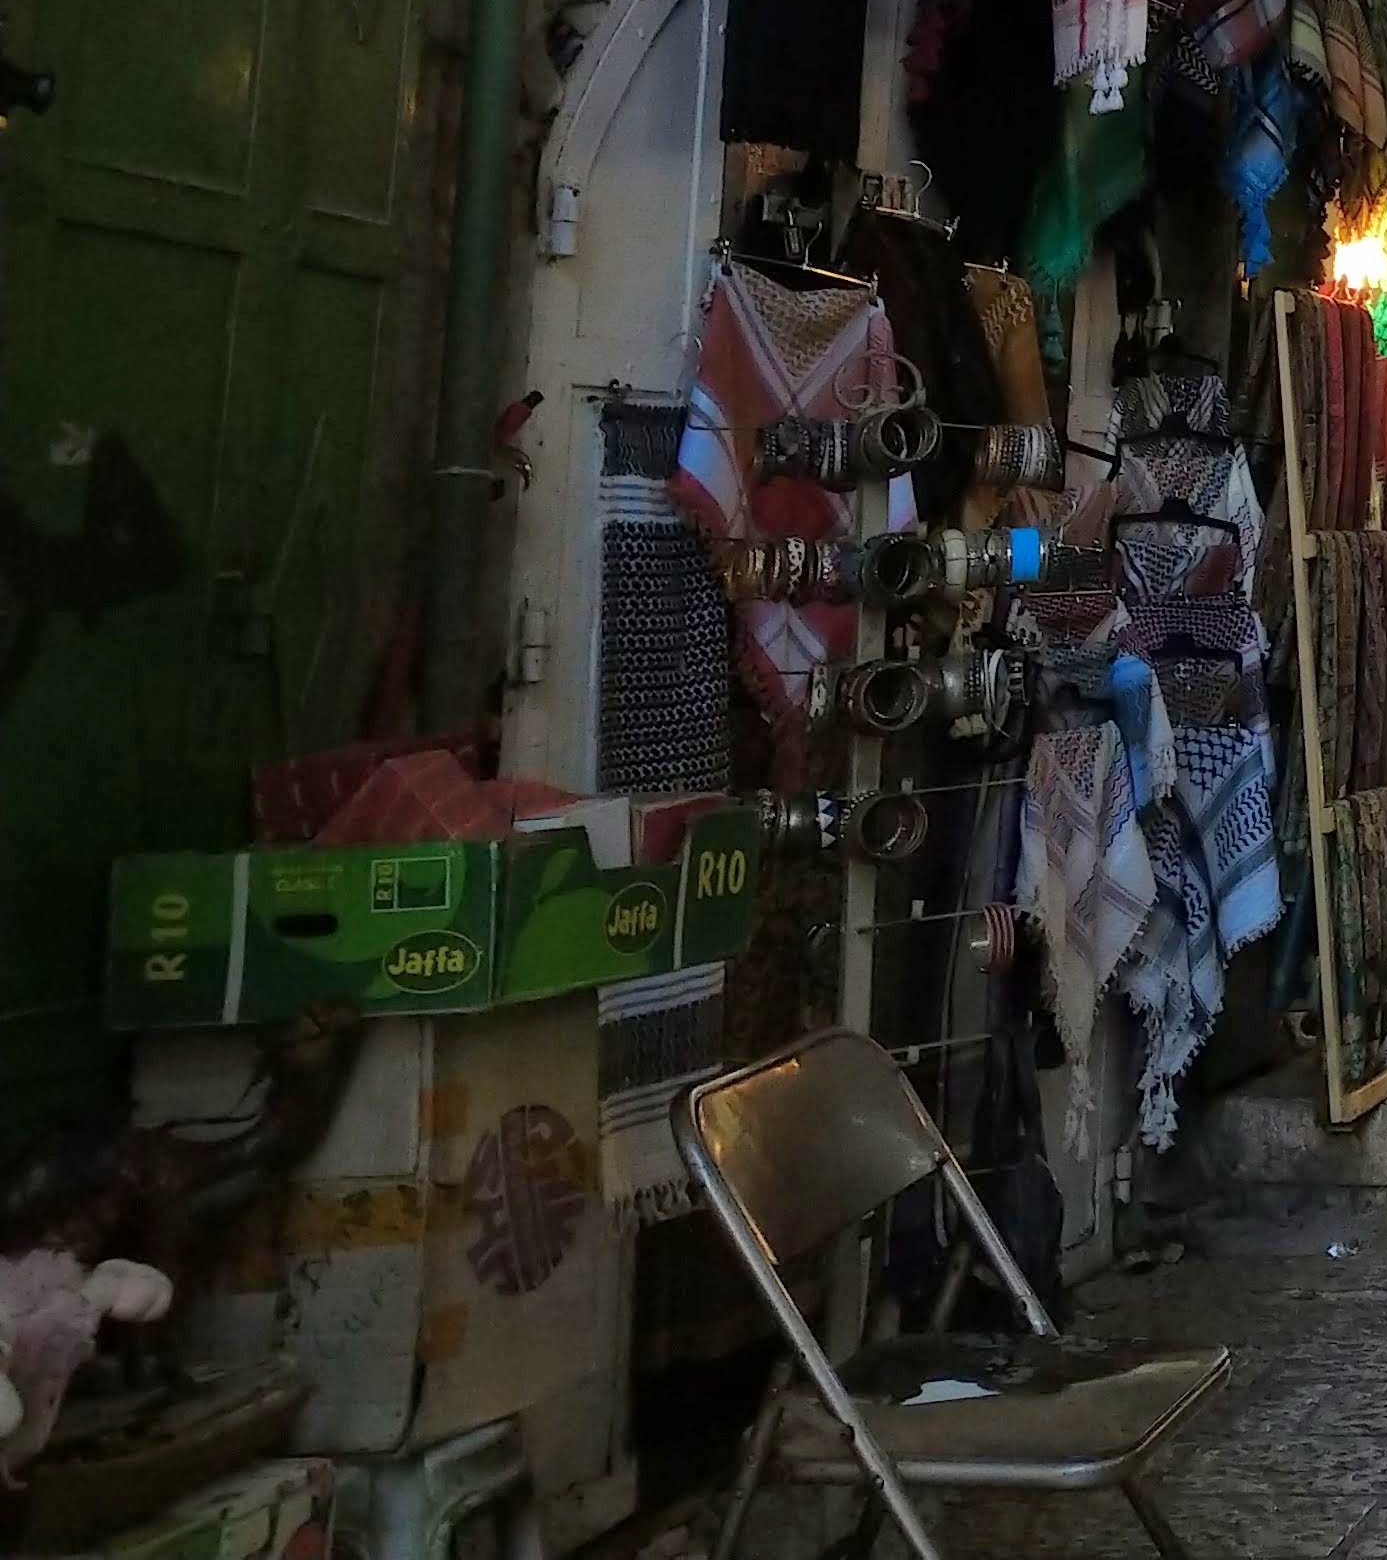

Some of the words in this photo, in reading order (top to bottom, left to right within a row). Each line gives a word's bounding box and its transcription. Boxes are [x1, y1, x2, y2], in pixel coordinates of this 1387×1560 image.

[375, 864, 394, 901] R10
[697, 849, 746, 900] R10
[607, 899, 658, 937] Jaffa
[144, 893, 190, 983] R10
[387, 945, 465, 977] Jaffa
